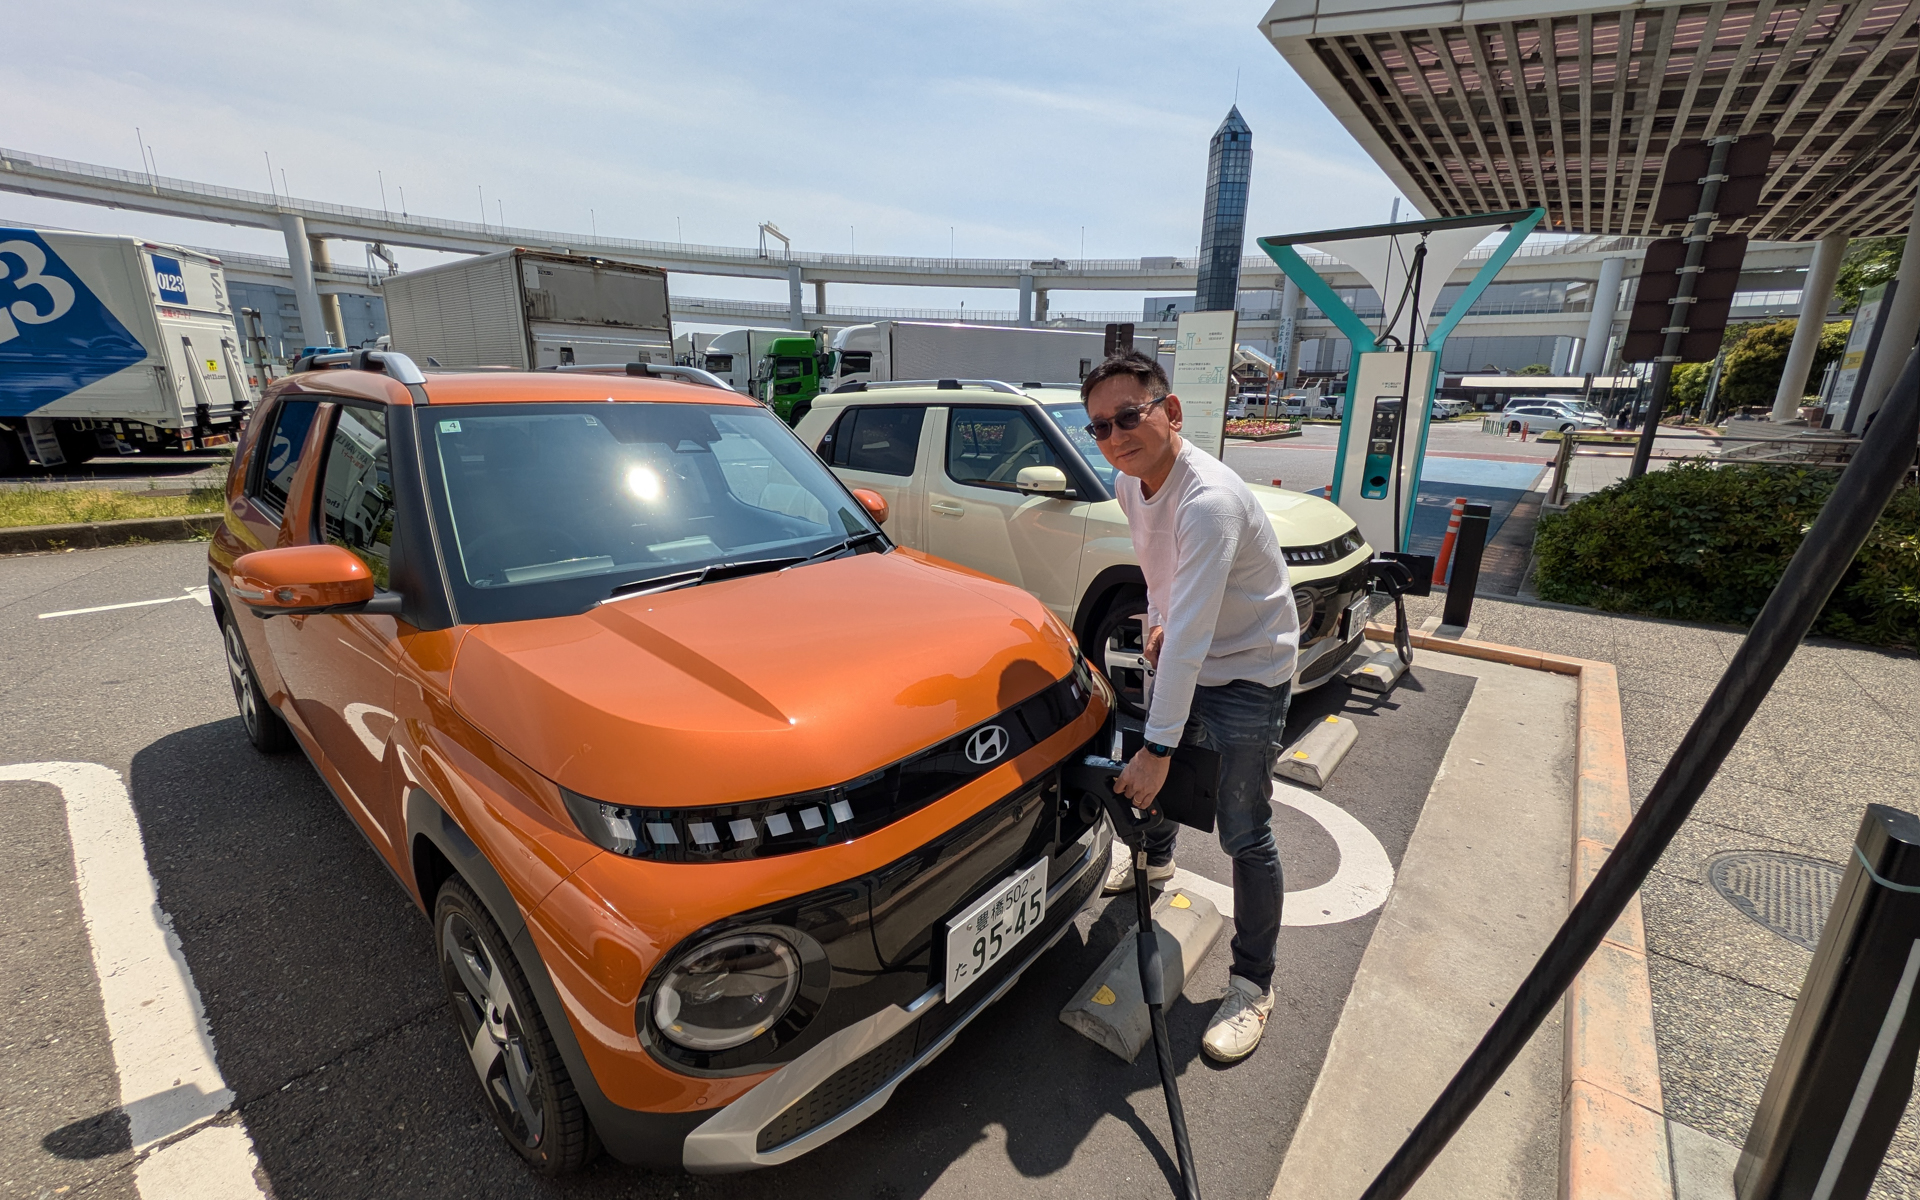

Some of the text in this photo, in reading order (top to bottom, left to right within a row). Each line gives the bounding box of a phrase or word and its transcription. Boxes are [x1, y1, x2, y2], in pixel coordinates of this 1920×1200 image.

[156, 272, 185, 293] 0123
[1005, 878, 1029, 911] 502
[953, 886, 1043, 983] た 95-45
